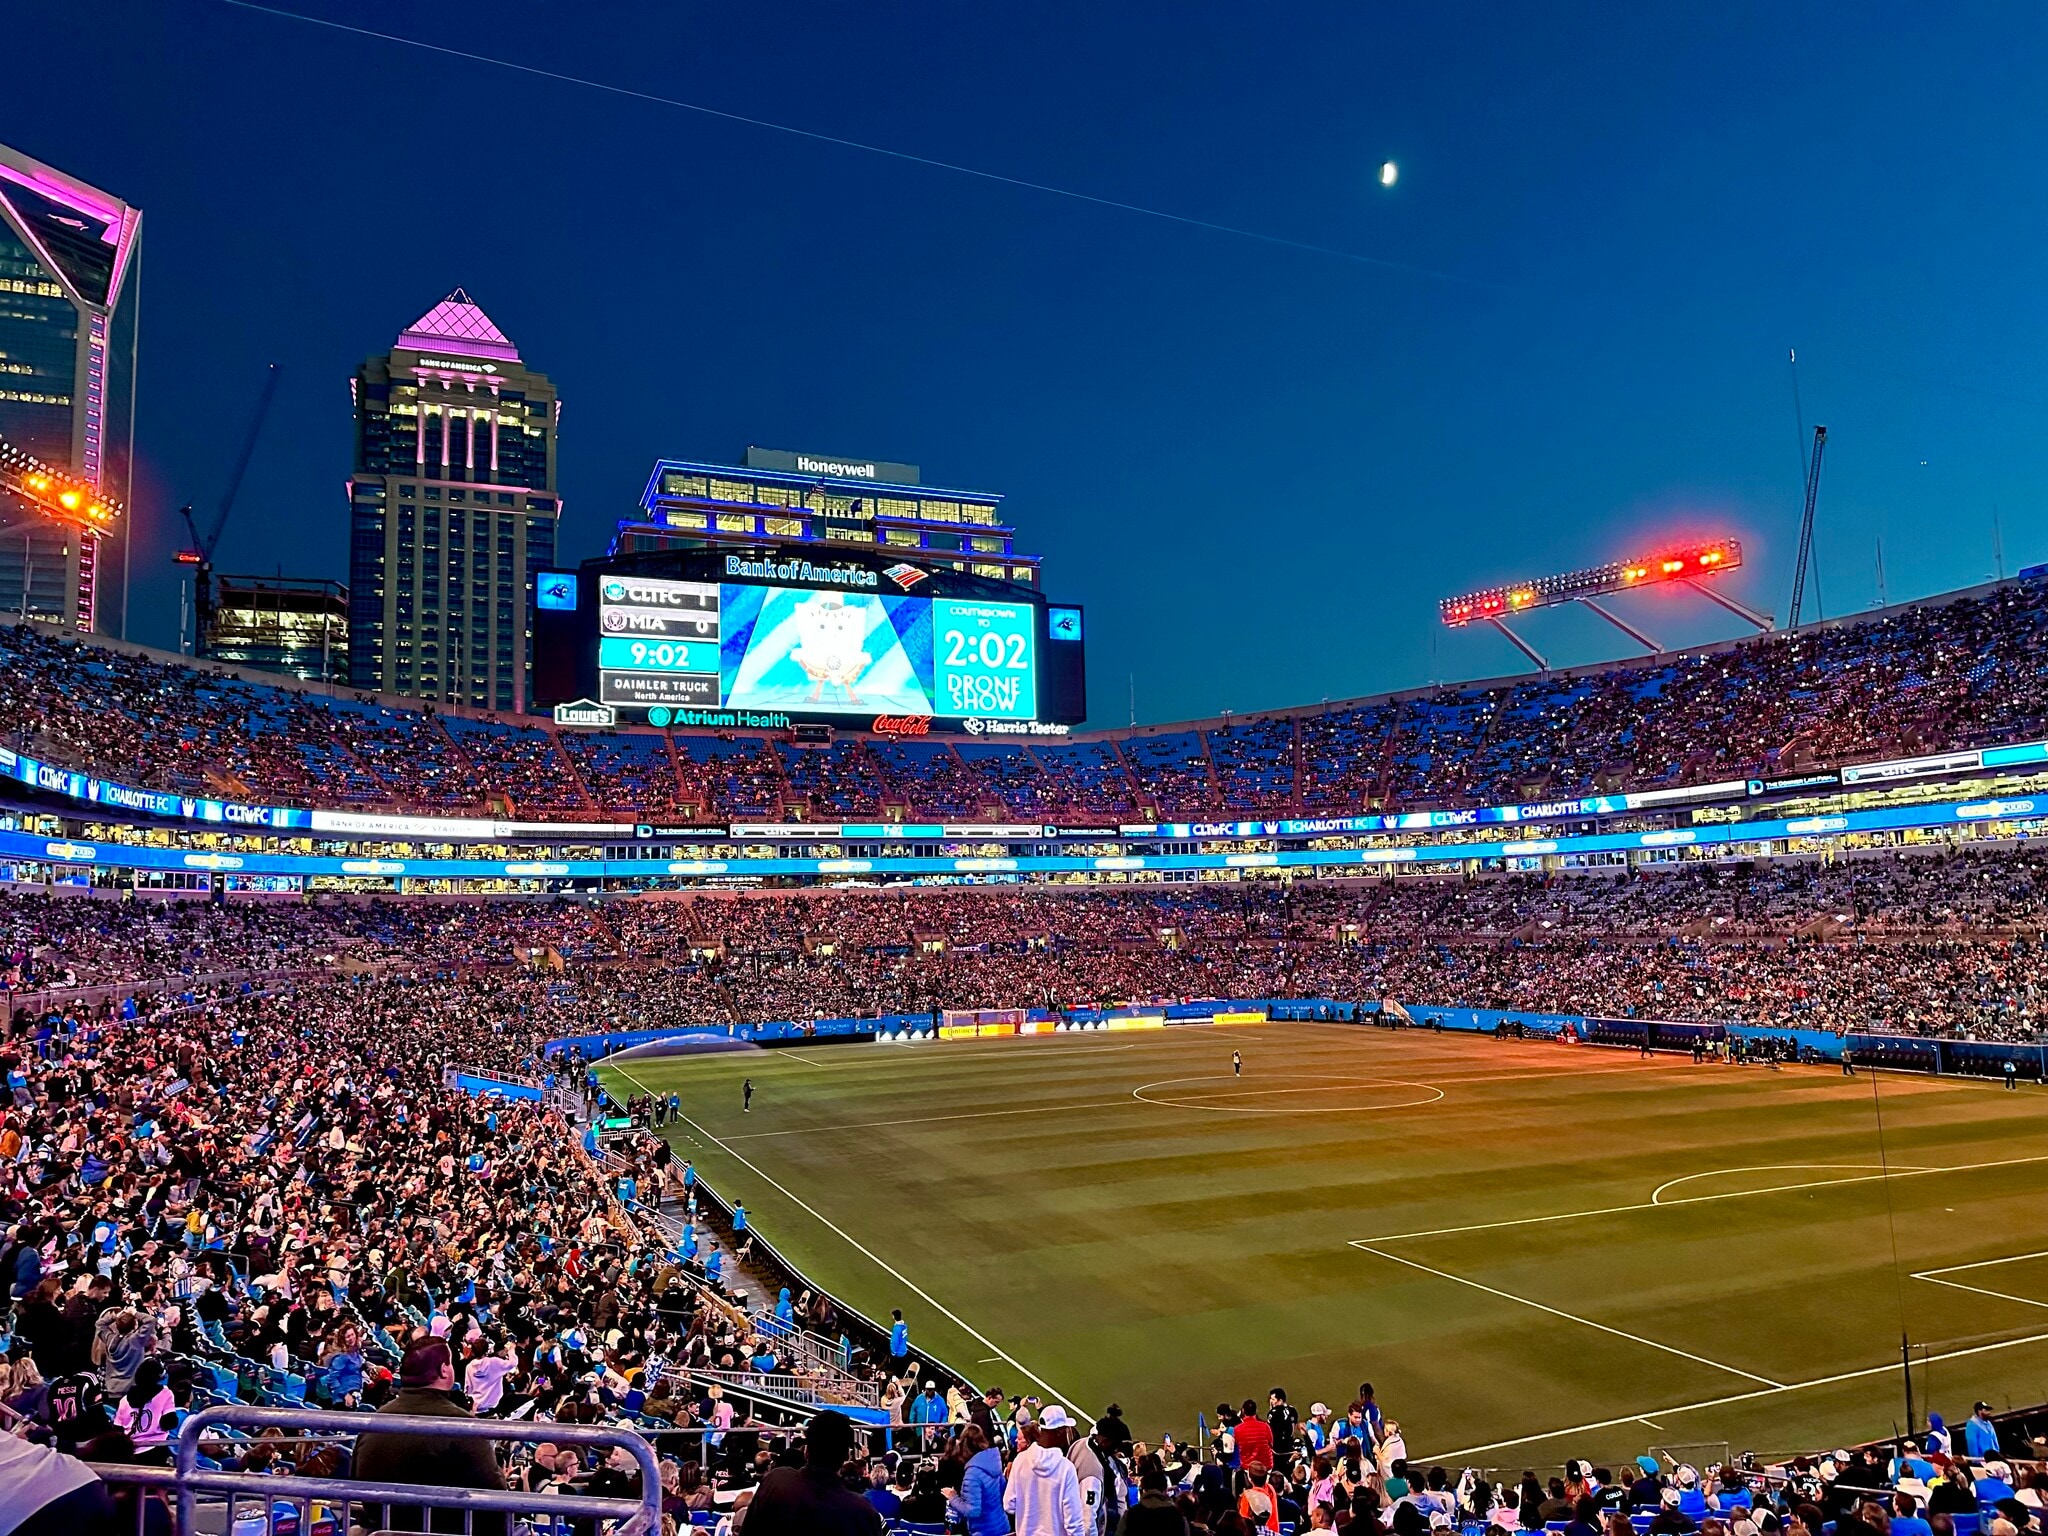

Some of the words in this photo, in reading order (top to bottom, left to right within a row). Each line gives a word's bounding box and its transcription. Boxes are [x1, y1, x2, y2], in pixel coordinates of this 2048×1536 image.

[420, 359, 440, 367] BANK
[450, 363, 482, 372] AMERICA
[797, 456, 875, 478] Honeywell
[726, 554, 777, 580] Bank
[777, 561, 799, 580] of
[799, 560, 878, 587] America
[628, 585, 683, 605] CLTFC
[629, 613, 667, 631] MIA
[696, 618, 709, 634] 0
[977, 618, 991, 628] TO
[631, 641, 690, 667] 9:02
[943, 629, 1029, 670] 2:02
[614, 678, 649, 691] DAIMLER
[652, 681, 709, 692] TRUCK
[947, 673, 1021, 696] DRONE
[634, 691, 657, 700] North
[659, 692, 690, 702] America
[952, 690, 1017, 712] SHOW
[673, 708, 735, 727] Atrium
[737, 710, 790, 728] Health
[985, 720, 1027, 734] Harris
[1028, 721, 1070, 735] Teeter
[108, 786, 155, 810] CHARLOTTE
[156, 796, 169, 811] FC
[1521, 804, 1579, 818] CHARLOTTE
[1580, 801, 1593, 812] FC
[1295, 820, 1353, 831] CHARLOTTE
[1355, 819, 1368, 828] FC
[57, 1386, 77, 1395] MESSI
[53, 1397, 77, 1422] 10
[1086, 1490, 1096, 1506] B
